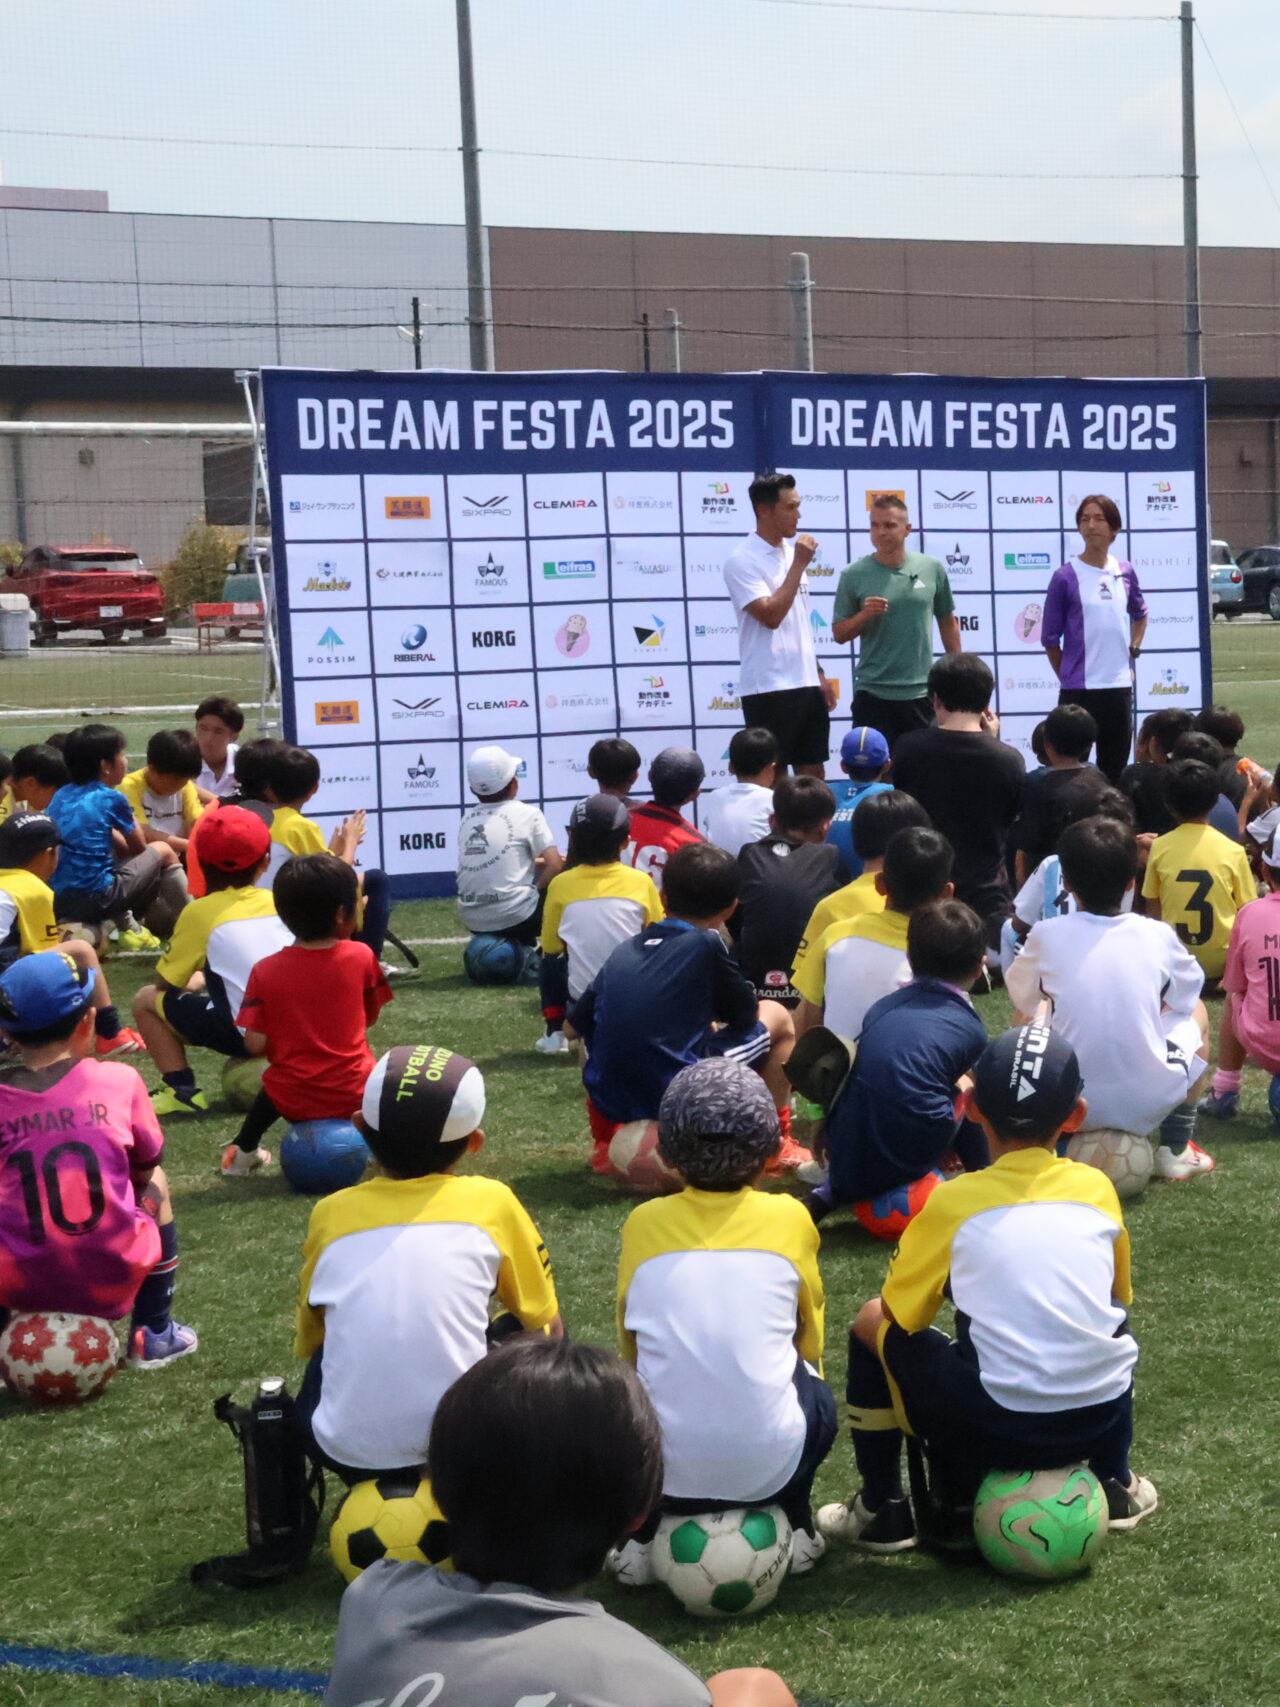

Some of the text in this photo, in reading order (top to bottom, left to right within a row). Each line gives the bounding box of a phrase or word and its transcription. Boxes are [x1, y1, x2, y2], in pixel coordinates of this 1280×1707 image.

[297, 397, 734, 451] DREAM FESTA 2025
[790, 397, 1177, 451] DREAM FESTA 2025
[533, 499, 598, 509] CLEMIRA
[996, 496, 1054, 505] CLEMIRA
[462, 508, 511, 517] SIXPAD
[474, 578, 508, 587] FAMOUS
[471, 630, 516, 648] KORG
[307, 655, 356, 664] POSSIM
[393, 653, 436, 662] RIBERAL
[466, 699, 530, 710] CLEMIRA
[391, 710, 445, 720] SIXPAD
[404, 779, 439, 789] FAMOUS
[399, 831, 446, 851] KORG
[1175, 869, 1214, 946] 3
[6, 1140, 105, 1246] 10
